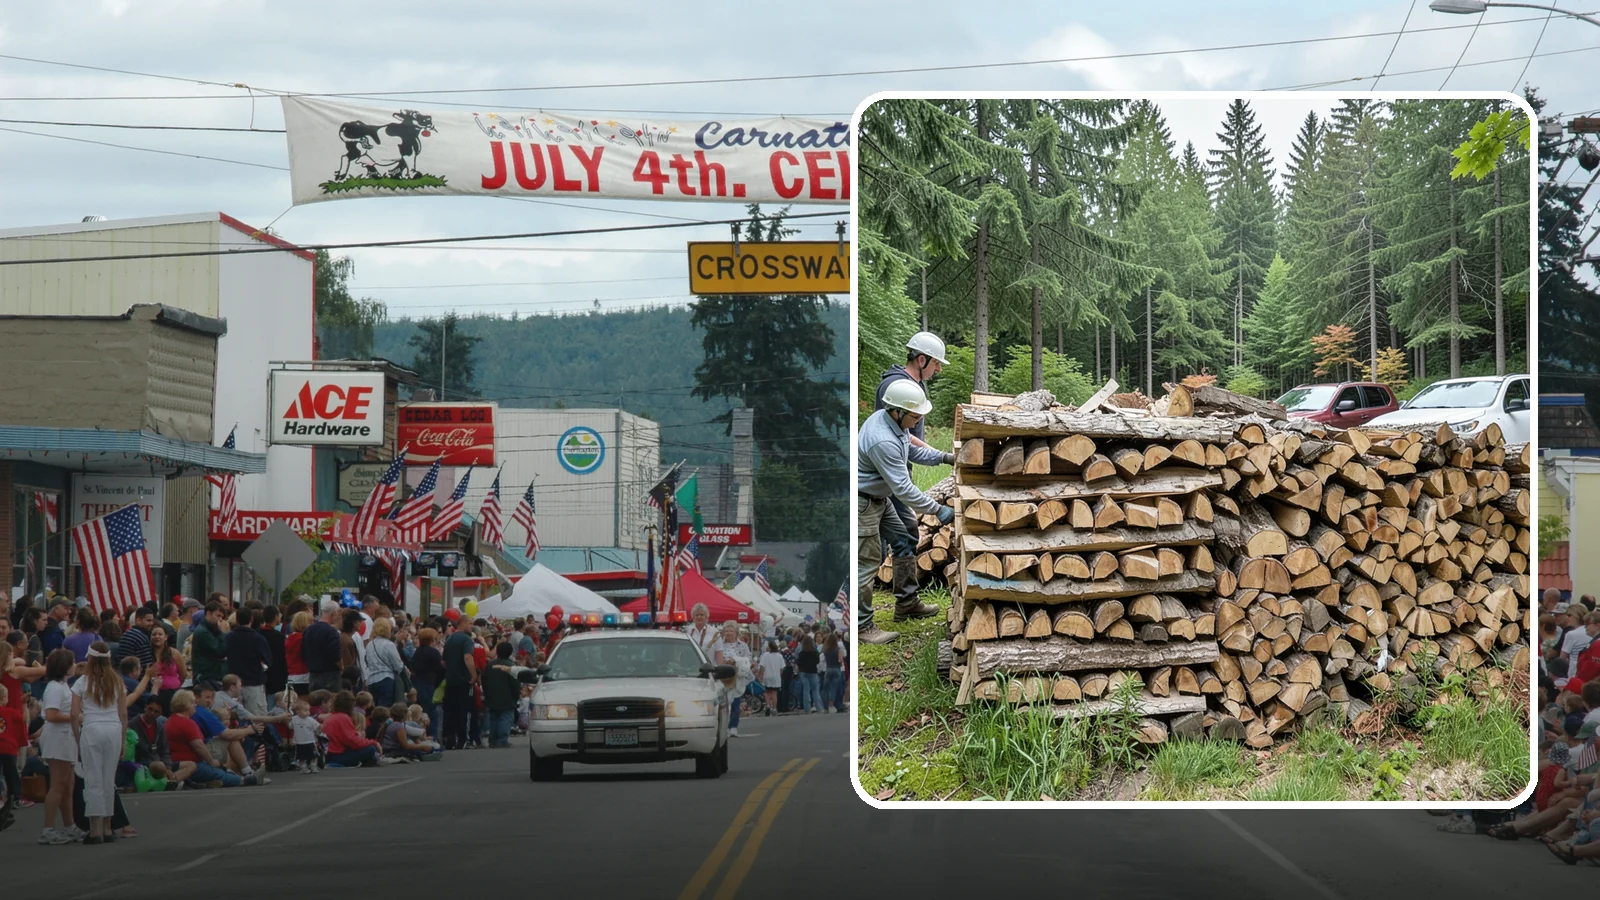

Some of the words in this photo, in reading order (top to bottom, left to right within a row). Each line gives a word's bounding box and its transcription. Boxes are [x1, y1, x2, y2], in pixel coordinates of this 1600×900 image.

[695, 121, 850, 149] Carnat
[481, 141, 604, 192] JULY
[632, 149, 746, 197] 4th.
[697, 254, 850, 280] CROSSWA
[282, 380, 373, 420] ACE
[405, 409, 452, 421] CEDAR
[283, 421, 371, 436] Hardware
[416, 428, 477, 447] Coca-Cola
[83, 485, 93, 494] St.
[95, 485, 124, 494] Vincent
[126, 486, 135, 494] de
[138, 486, 155, 495] Paul
[688, 526, 741, 535] CRNATION
[699, 535, 730, 543] GLASS
